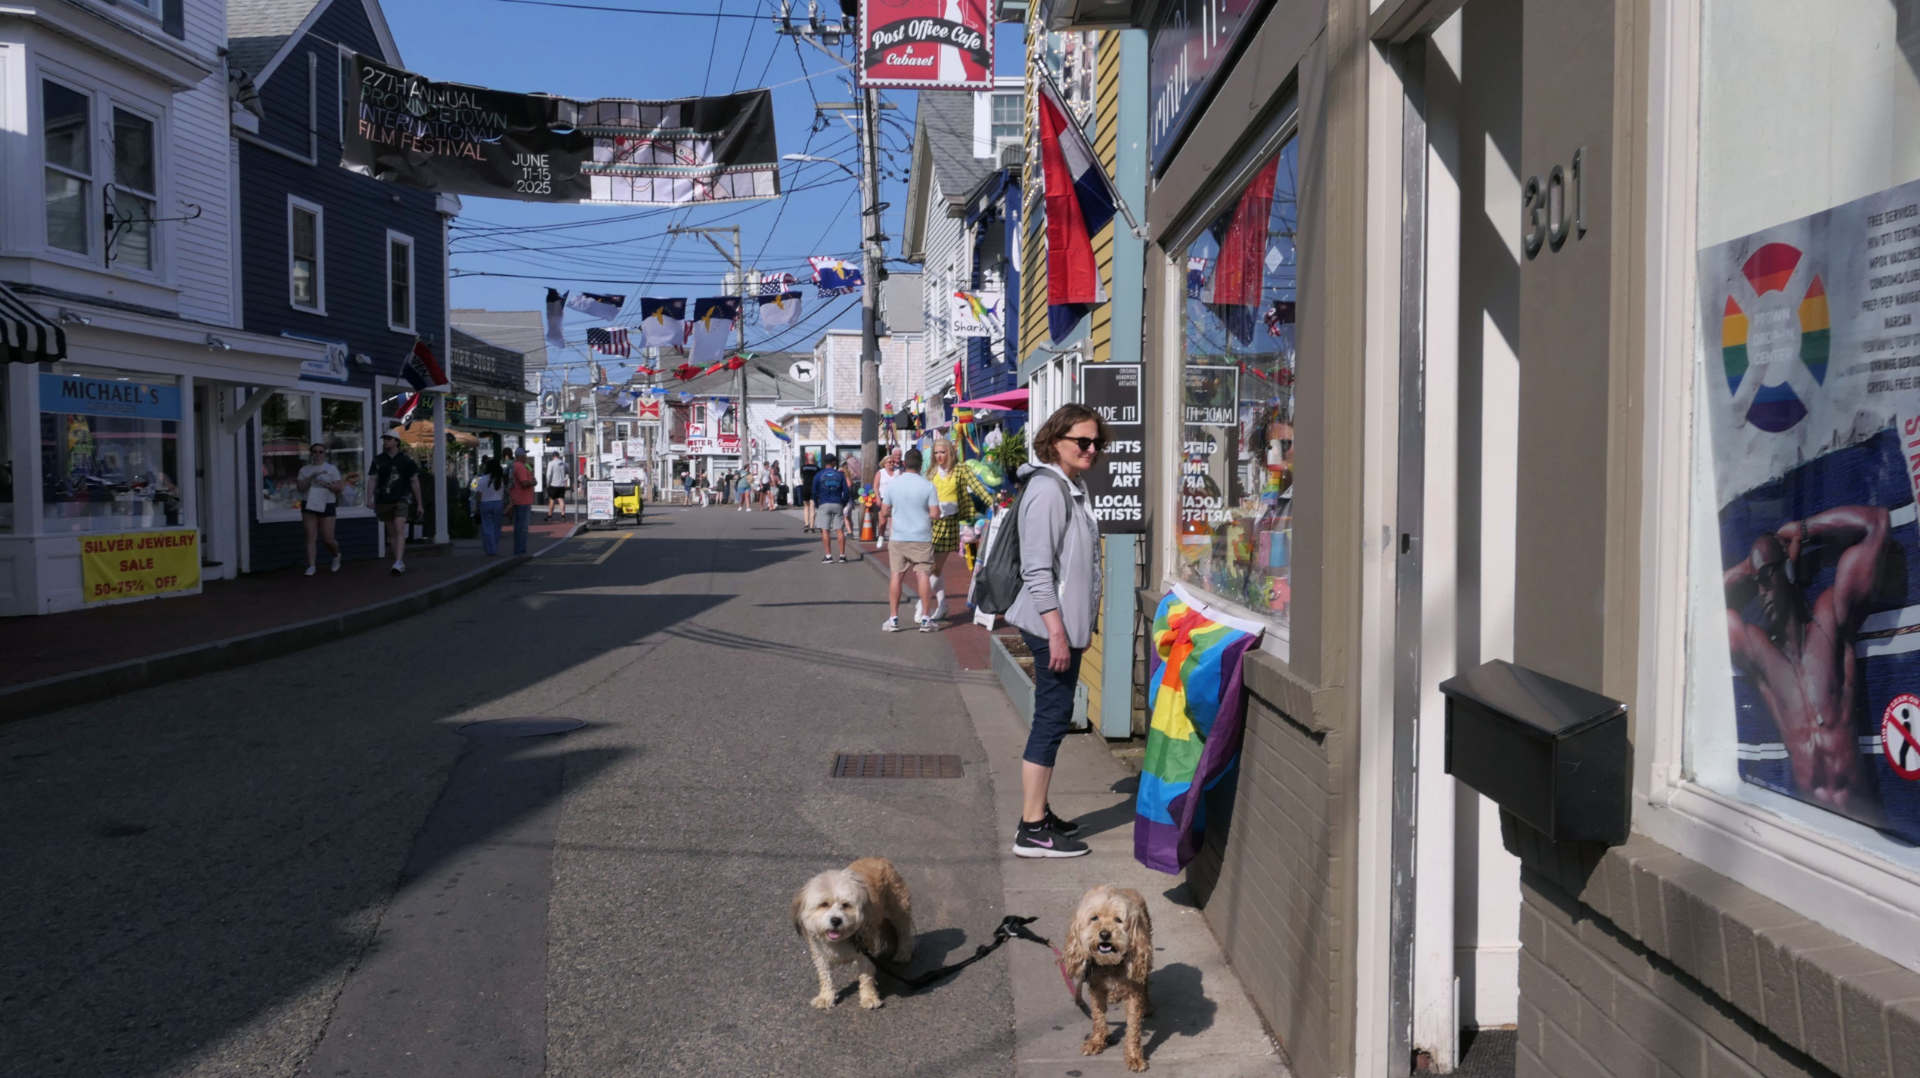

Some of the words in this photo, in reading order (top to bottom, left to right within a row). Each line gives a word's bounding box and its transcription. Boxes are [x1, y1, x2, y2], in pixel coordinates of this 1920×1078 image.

[872, 24, 905, 50] Post
[908, 19, 949, 40] Office
[951, 26, 981, 49] Cafe
[886, 53, 935, 66] Cabaret
[362, 66, 407, 95] 27TH
[410, 81, 482, 110] ANNUAL
[360, 85, 508, 128] PROVINCETOWN
[360, 102, 502, 144] INTERNATIONAL
[358, 120, 395, 145] FILM
[401, 133, 487, 161] FESTIVAL
[511, 153, 550, 168] JUNE
[522, 167, 552, 181] 11-15
[516, 179, 552, 194] 2025
[1523, 146, 1588, 260] 301
[1108, 461, 1141, 474] FINE
[1112, 474, 1141, 488] ART
[1094, 494, 1141, 508] LOCAL
[1092, 507, 1141, 521] RTISTS
[84, 538, 134, 554] SILVER
[136, 533, 195, 550] JEWELRY
[119, 558, 154, 573] SALE
[94, 579, 145, 597] 50-75%
[155, 576, 178, 590] OFF
